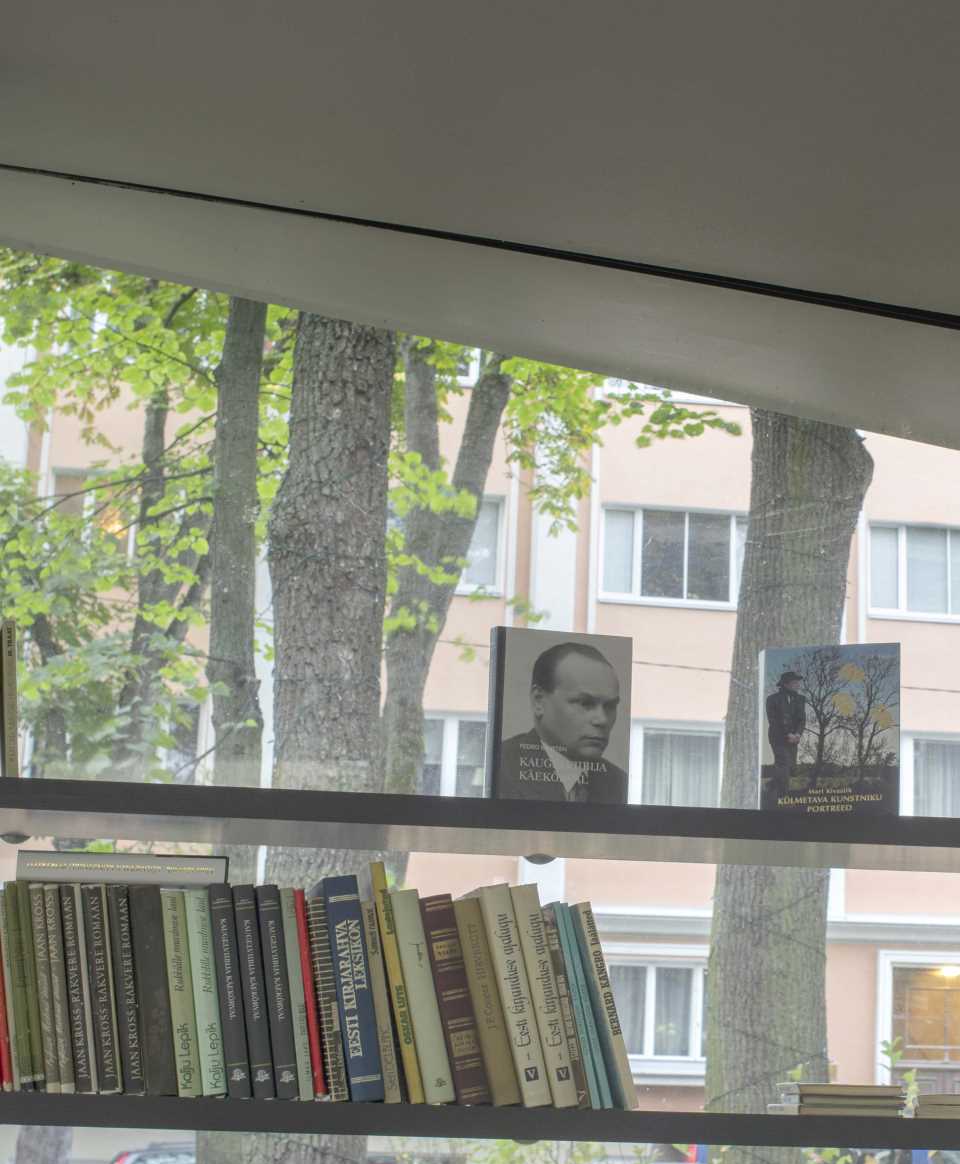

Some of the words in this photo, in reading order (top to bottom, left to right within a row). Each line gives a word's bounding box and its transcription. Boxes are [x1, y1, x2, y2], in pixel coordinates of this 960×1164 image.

[32, 894, 45, 929] KROSS
[43, 894, 57, 930] KROSS
[59, 895, 77, 947] ROMAAN
[86, 894, 103, 947] ROMAAN
[117, 896, 132, 949] ROMAAN
[34, 932, 47, 961] JAAN
[46, 932, 60, 962] JAAN
[347, 918, 367, 991] LEKSIKON
[334, 919, 357, 1012] KIRJARAHVA
[71, 1007, 86, 1046] KROSS
[97, 1007, 112, 1046] KROSS
[125, 1009, 139, 1047] KROSS
[601, 990, 621, 1036] BERNARD
[176, 1022, 192, 1057] Lepik
[204, 1022, 219, 1057] Lepik
[347, 1012, 363, 1057] EESTI
[76, 1048, 90, 1079] JAAN
[101, 1048, 115, 1078] JAAN
[128, 1050, 141, 1080] JAAN
[180, 1058, 195, 1090] Kalju
[207, 1058, 222, 1090] Kalju
